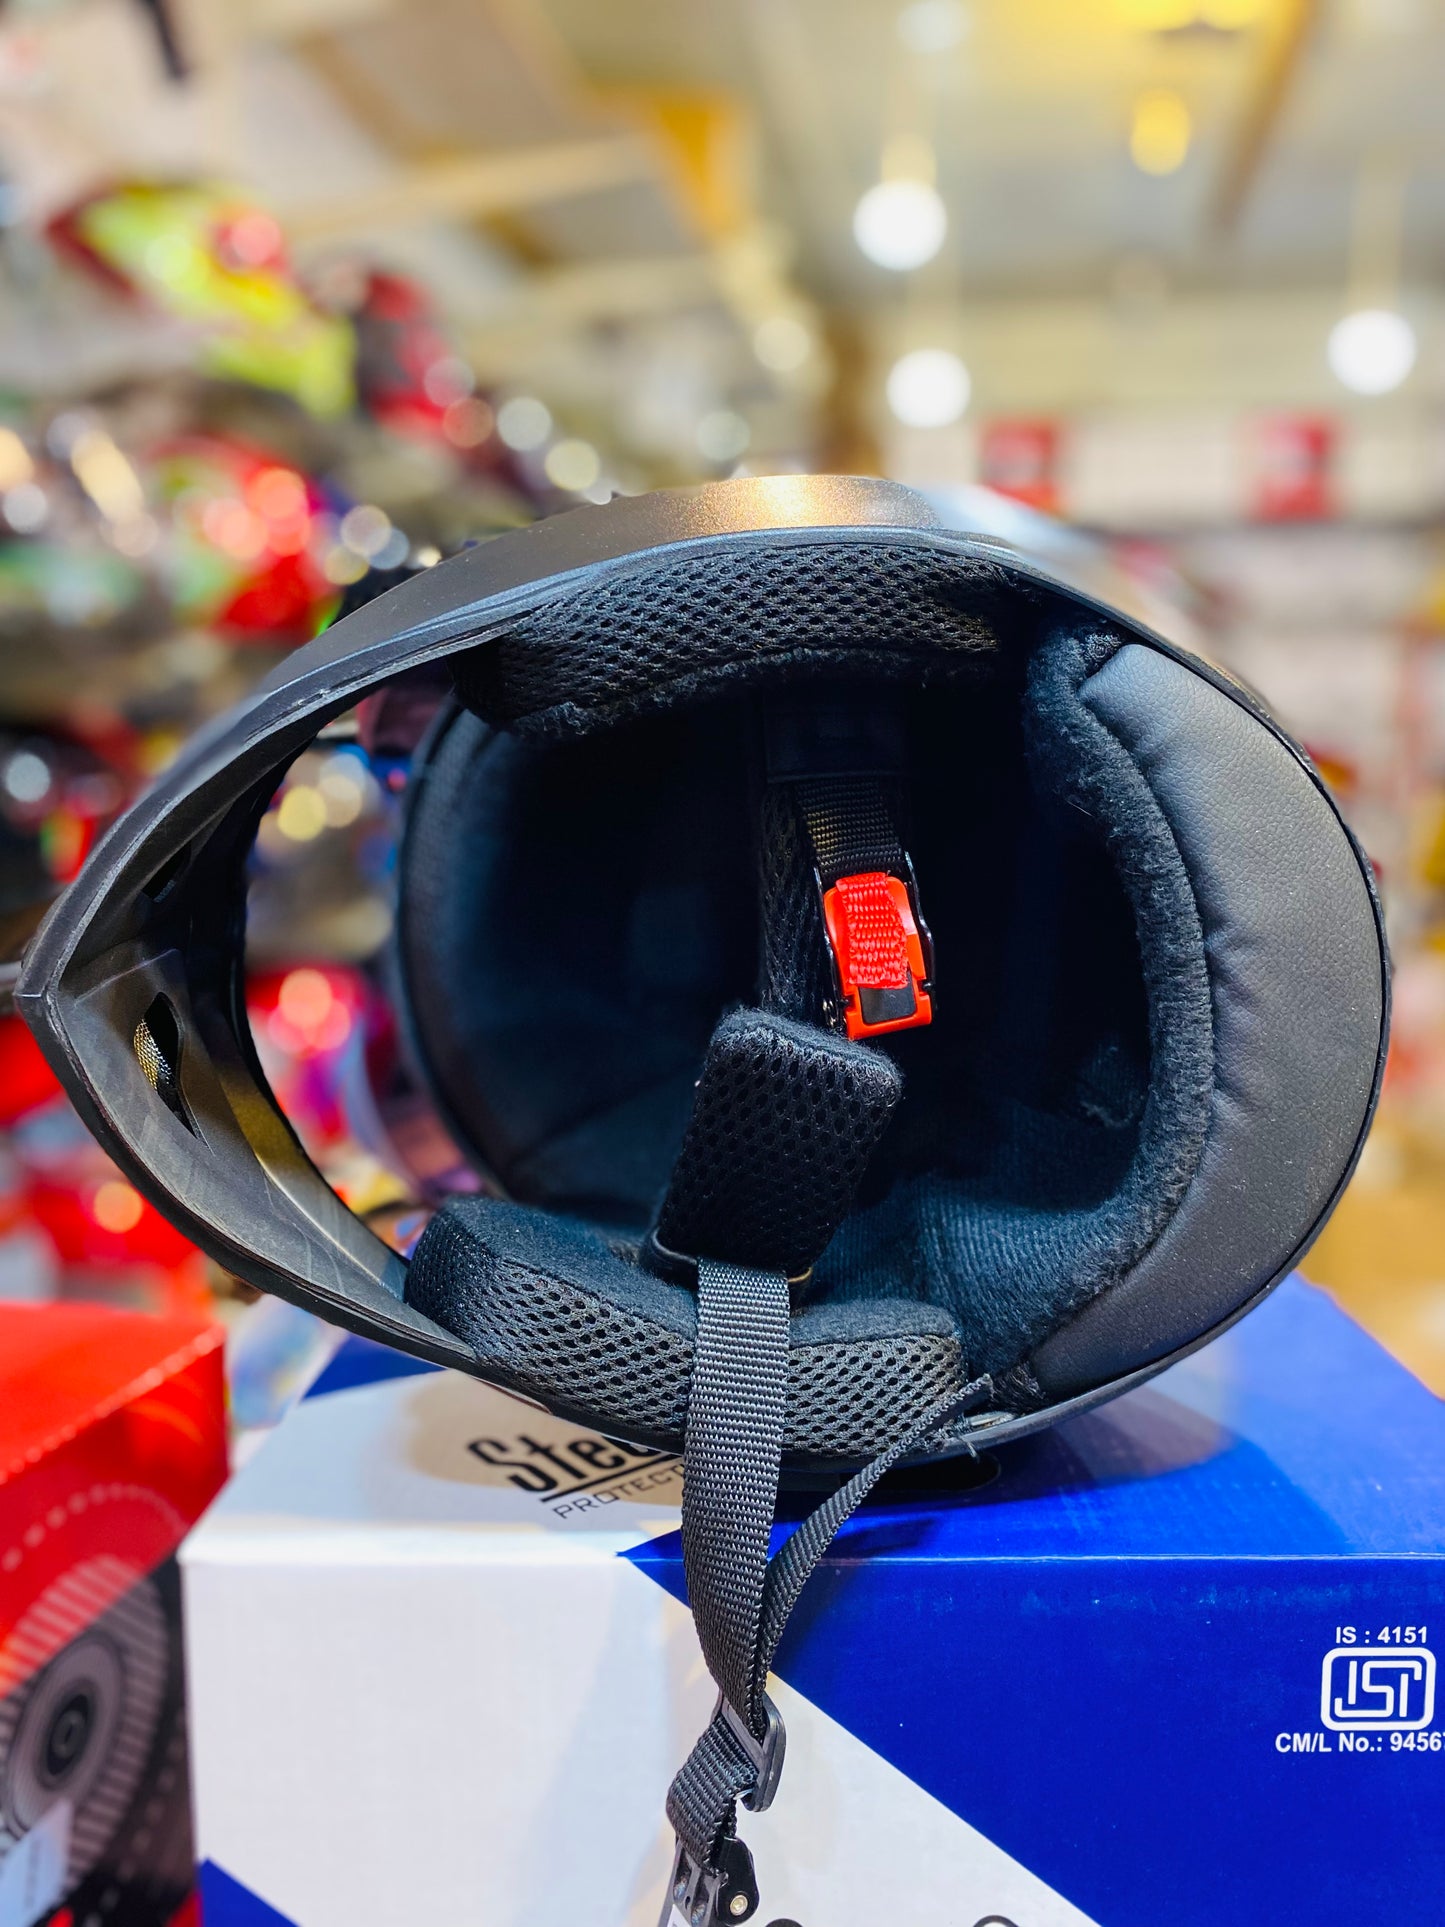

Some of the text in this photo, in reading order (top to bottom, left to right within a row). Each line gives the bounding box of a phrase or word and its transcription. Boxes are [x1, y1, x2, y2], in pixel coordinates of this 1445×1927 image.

[1335, 1626, 1357, 1644] IS
[1377, 1626, 1427, 1644] 4151
[1275, 1732, 1332, 1752] CM/L
